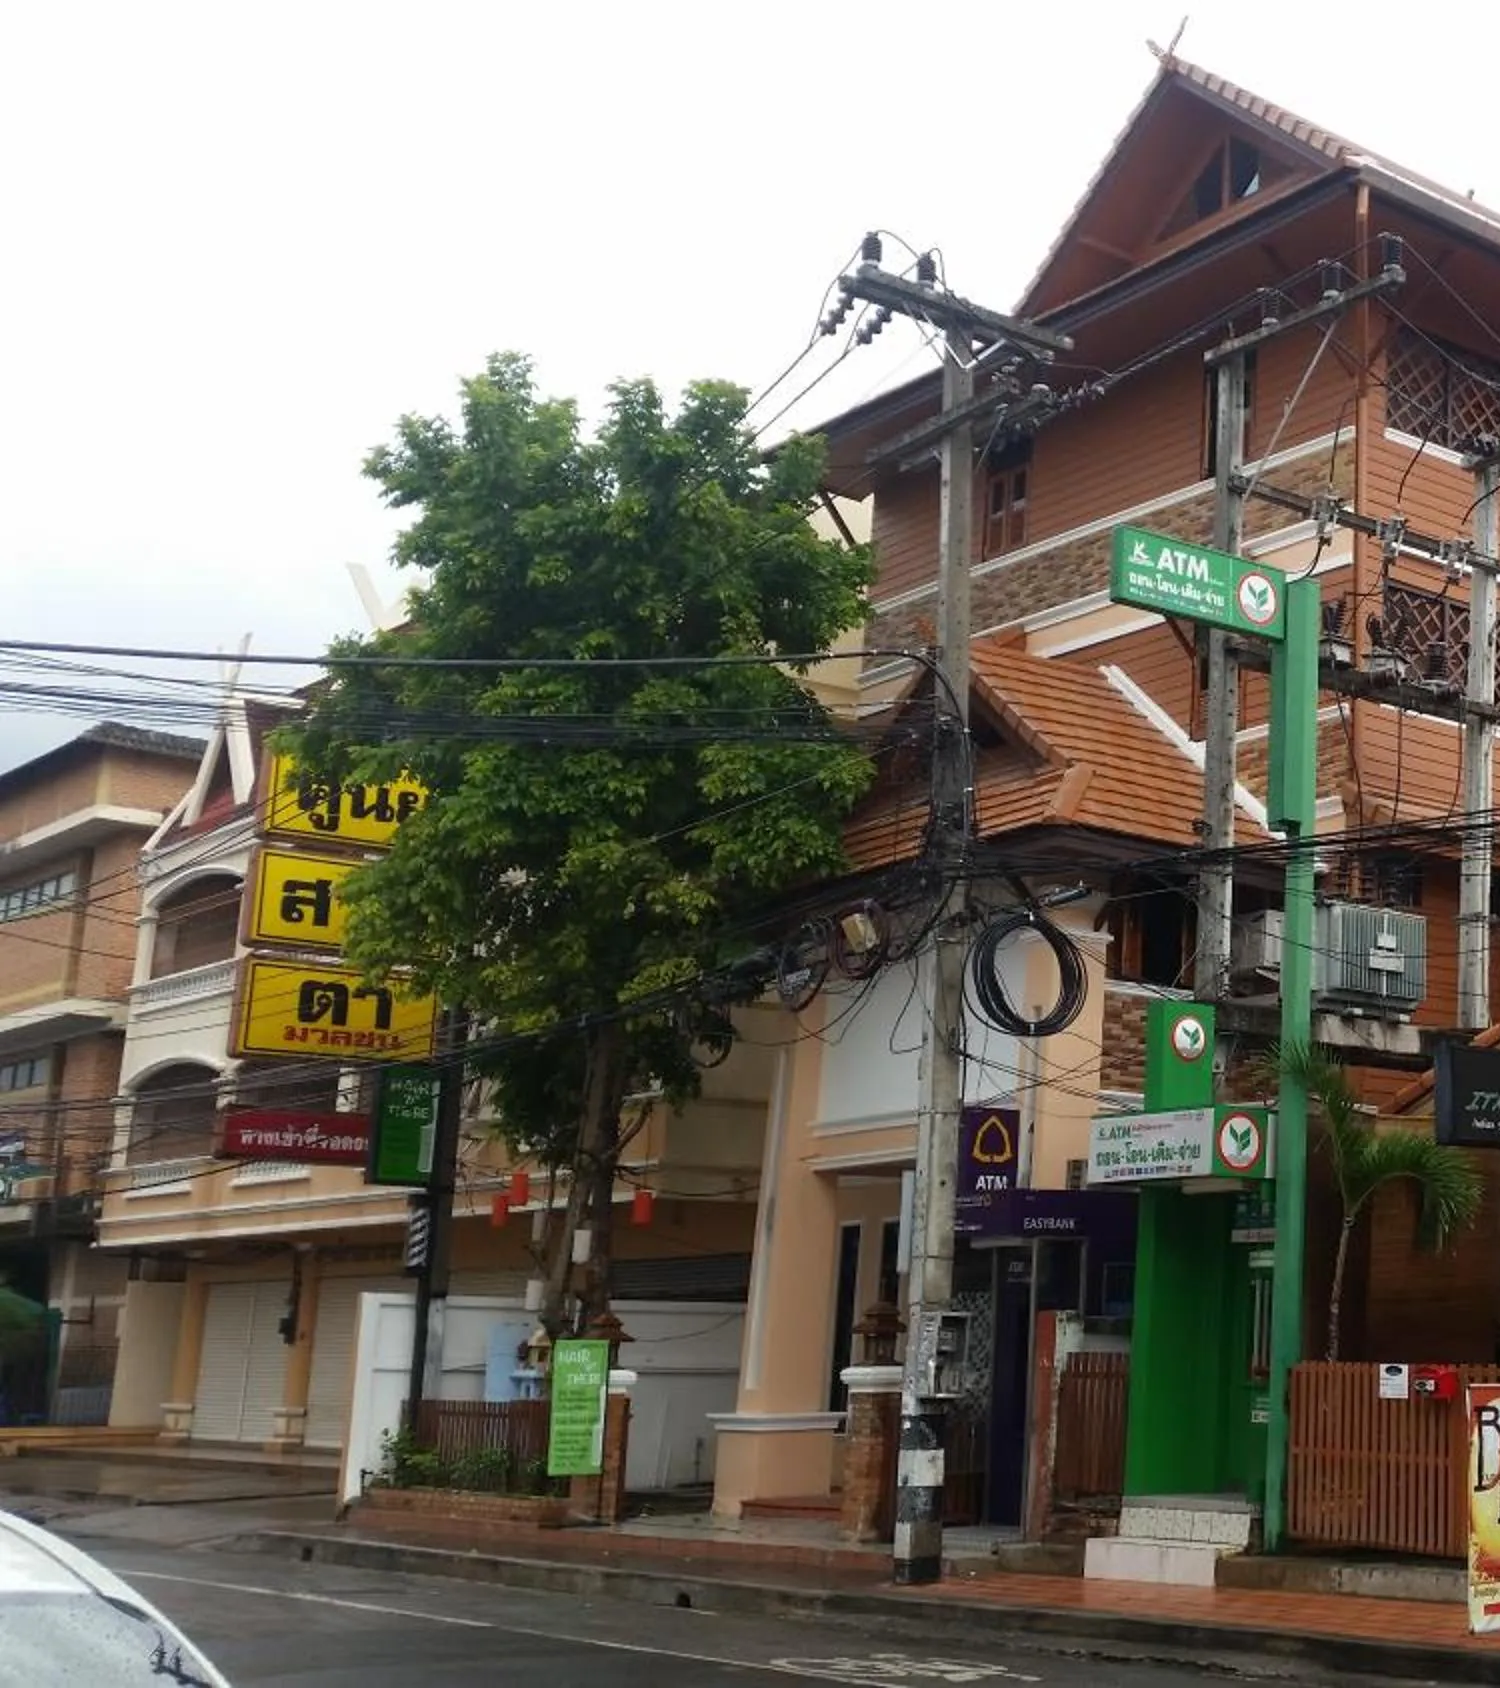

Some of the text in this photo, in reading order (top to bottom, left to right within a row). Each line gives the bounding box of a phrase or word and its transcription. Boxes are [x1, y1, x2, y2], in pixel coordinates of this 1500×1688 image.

[1157, 546, 1210, 583] ATM
[298, 980, 394, 1030] ตา
[1109, 1123, 1133, 1140] ATM
[975, 1175, 1008, 1190] ATM
[1023, 1217, 1076, 1230] EASYBANK
